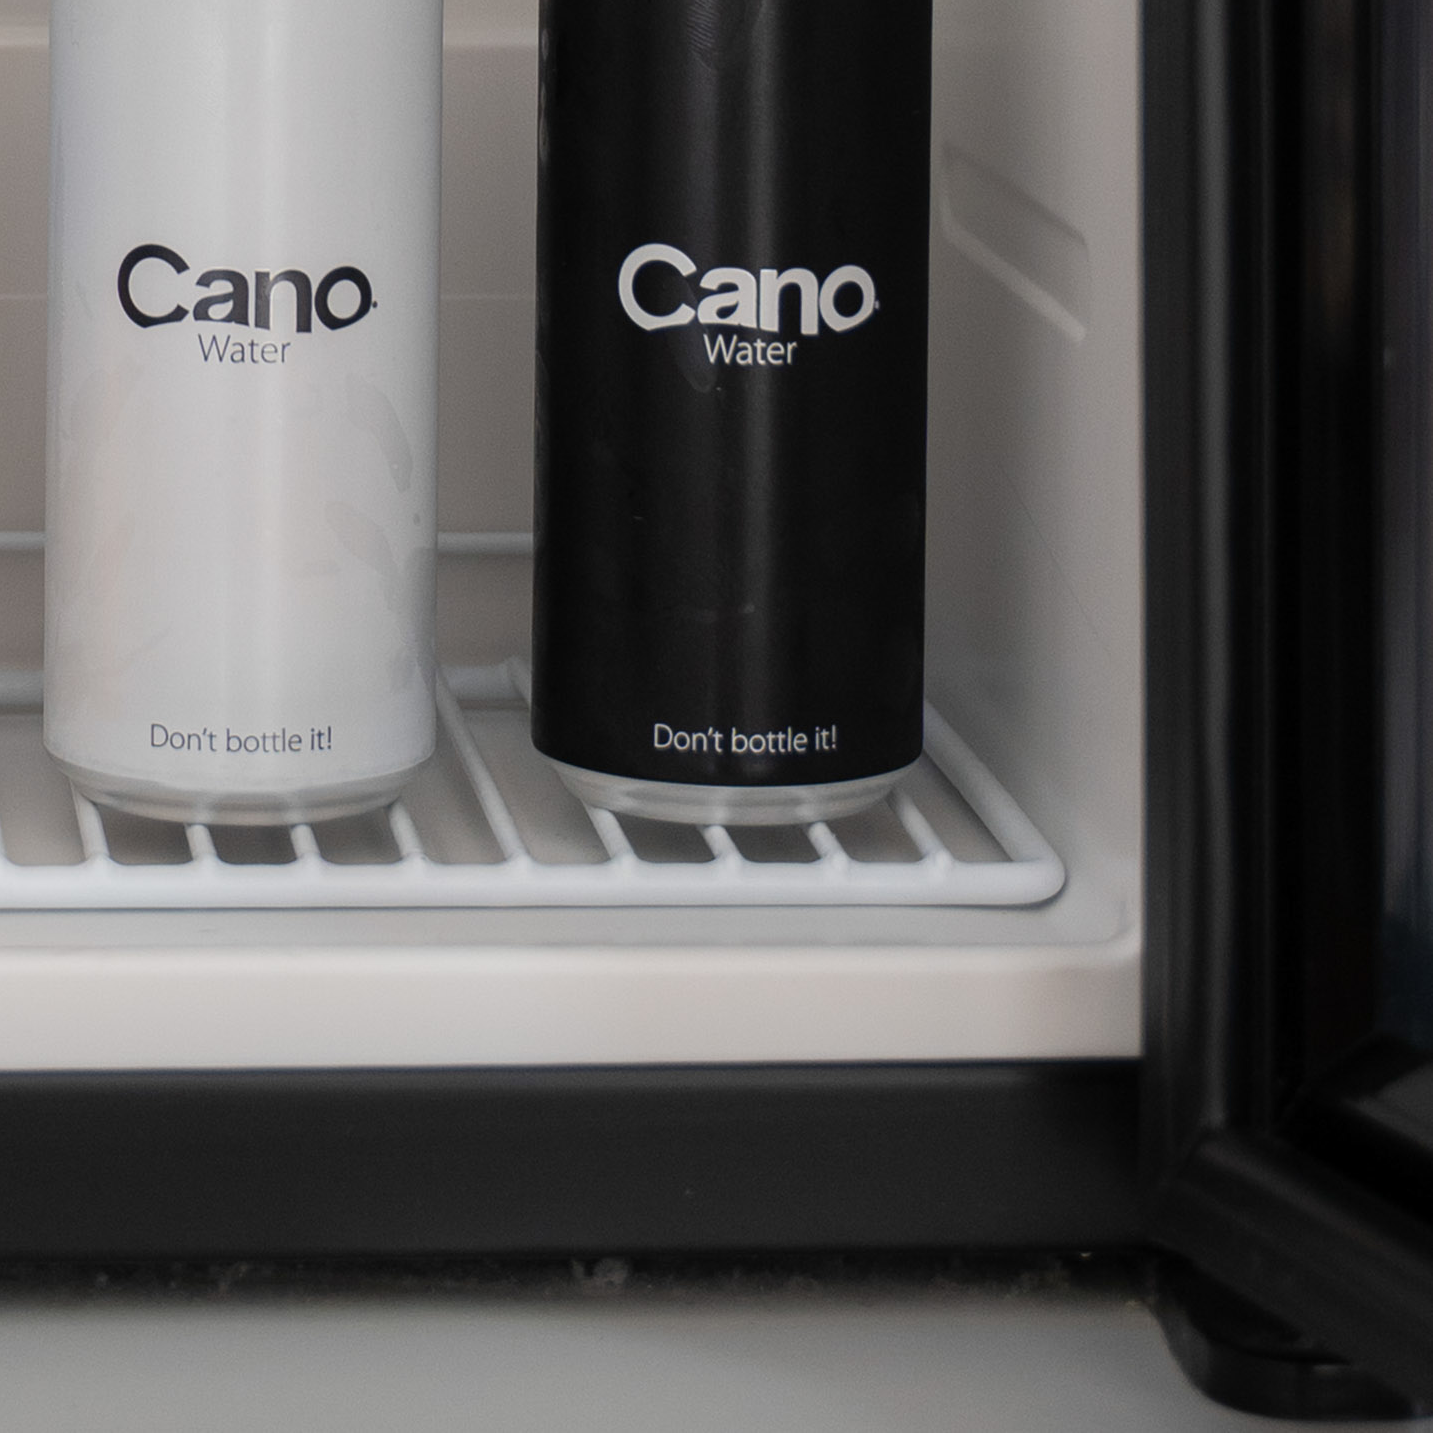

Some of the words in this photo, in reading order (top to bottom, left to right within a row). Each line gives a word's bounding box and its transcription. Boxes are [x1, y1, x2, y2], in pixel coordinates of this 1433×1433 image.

[117, 243, 374, 333] Cano
[618, 243, 877, 336] Cano
[198, 334, 291, 364] Water
[703, 334, 798, 365] Water
[150, 723, 217, 753] Don't
[225, 727, 303, 753] bottle
[310, 726, 333, 751] it!
[653, 723, 724, 753] Don't
[731, 726, 809, 753] bottle
[815, 725, 837, 750] it!
